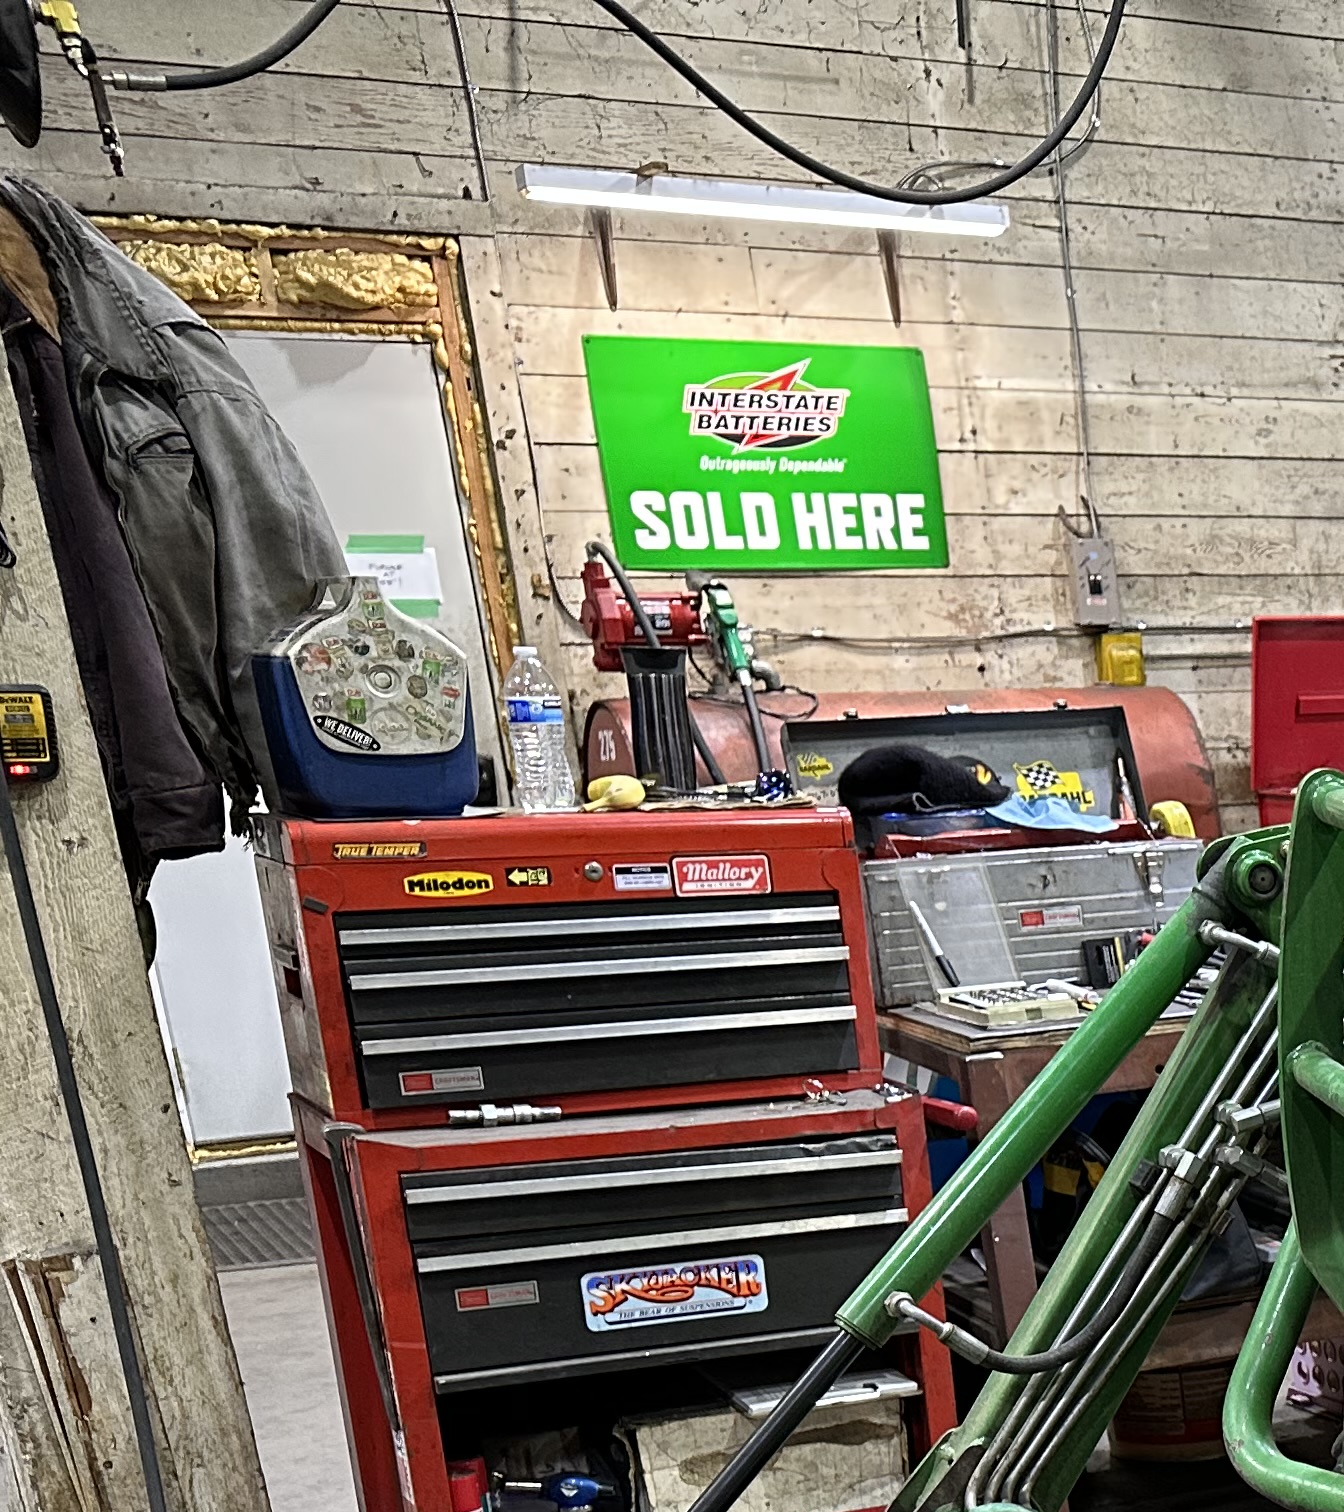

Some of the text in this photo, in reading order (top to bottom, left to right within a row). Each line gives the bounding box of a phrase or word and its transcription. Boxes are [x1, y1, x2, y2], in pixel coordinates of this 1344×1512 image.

[689, 390, 840, 412] INTERSTATE
[697, 413, 832, 433] BATTERIES
[699, 454, 776, 474] Outrageously
[629, 490, 930, 550] SOLD HERE
[323, 716, 374, 746] WE DELIVER!
[335, 842, 420, 858] TRUE TEMPER
[682, 862, 764, 882] Mallory
[406, 877, 490, 893] Milodon
[618, 1310, 635, 1320] THE
[664, 1304, 677, 1314] OF
